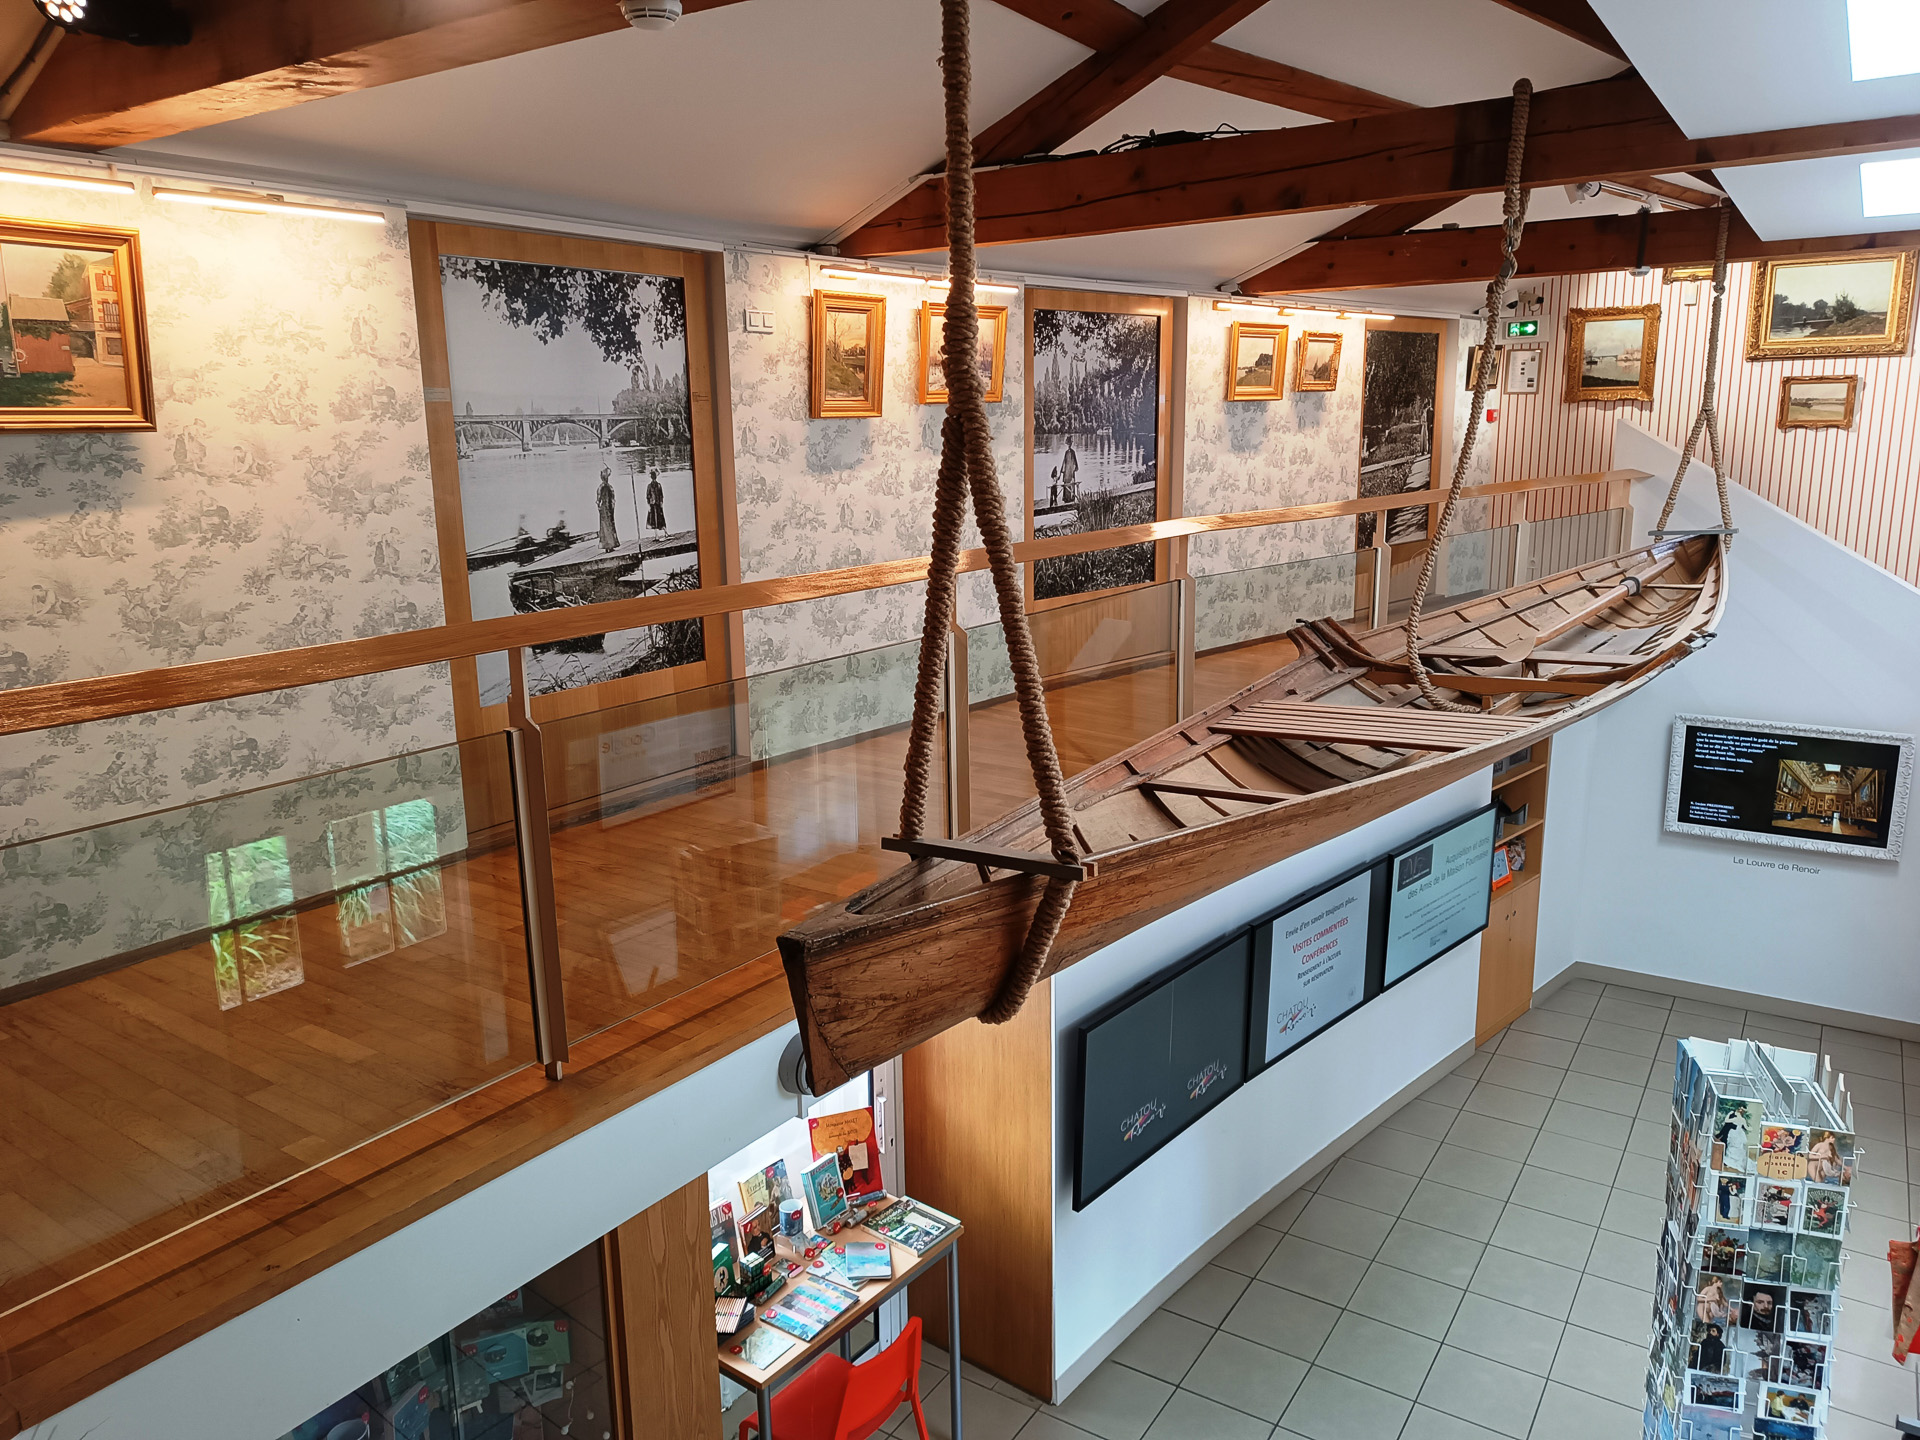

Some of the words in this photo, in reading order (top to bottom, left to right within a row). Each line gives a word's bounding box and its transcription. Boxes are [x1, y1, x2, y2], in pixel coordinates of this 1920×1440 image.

[1446, 845, 1471, 864] Acquisition
[1473, 842, 1477, 850] et
[1478, 837, 1490, 847] dons
[1733, 856, 1744, 864] Le
[1747, 858, 1776, 869] Louvre
[1778, 862, 1789, 871] de
[1792, 863, 1821, 875] Renoir
[1408, 889, 1417, 899] des
[1419, 881, 1432, 893] Amis
[1433, 876, 1440, 885] de
[1441, 873, 1446, 881] la
[1447, 863, 1464, 878] Maison
[1286, 926, 1298, 939] Envie
[1300, 922, 1310, 931] d'en
[1311, 912, 1324, 925] savoir
[1325, 902, 1344, 916] toujours
[1292, 937, 1312, 953] VISITES
[1302, 938, 1338, 965] CONFÉRENCES
[1277, 996, 1308, 1024] CHATOU
[1187, 1058, 1220, 1090] CHATOU
[1120, 1097, 1157, 1132] CHATOU
